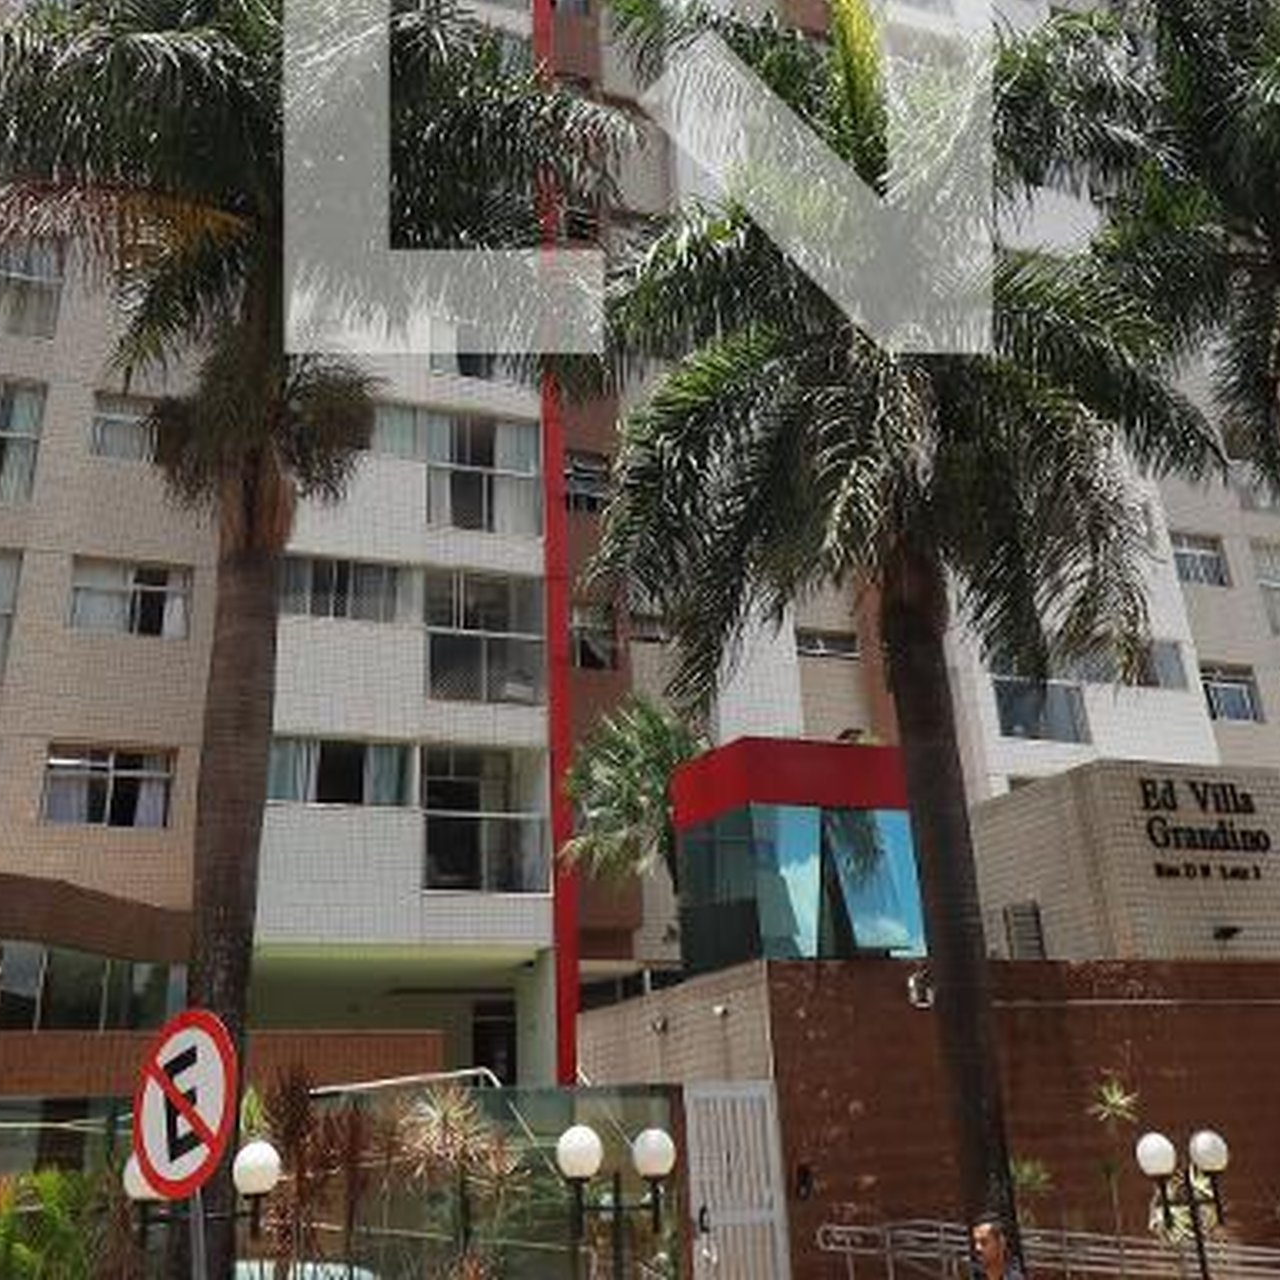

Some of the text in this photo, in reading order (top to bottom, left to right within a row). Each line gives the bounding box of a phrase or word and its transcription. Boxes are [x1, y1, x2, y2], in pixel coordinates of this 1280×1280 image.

[1139, 778, 1255, 814] Ed Villa
[1146, 816, 1270, 852] Grandino
[163, 1044, 207, 1162] E
